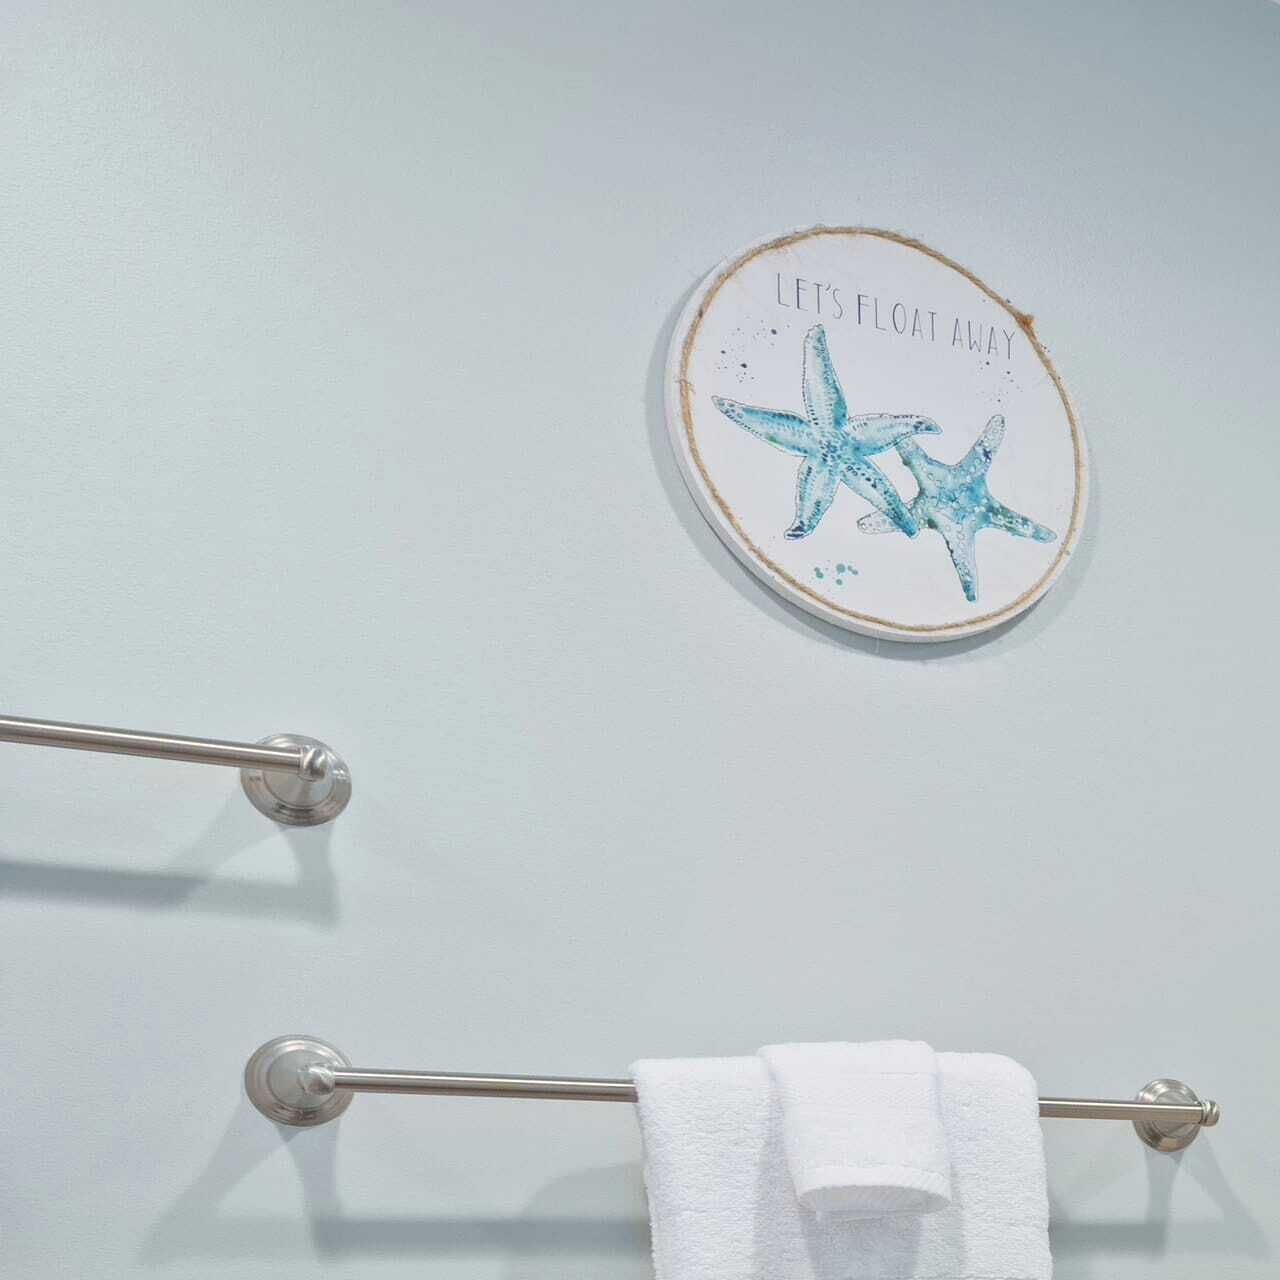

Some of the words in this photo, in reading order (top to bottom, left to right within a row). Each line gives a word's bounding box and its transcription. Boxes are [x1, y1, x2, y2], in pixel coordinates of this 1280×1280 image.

[776, 272, 843, 319] LET'S
[856, 293, 937, 341] FLOAT
[951, 317, 1016, 360] AWAY
